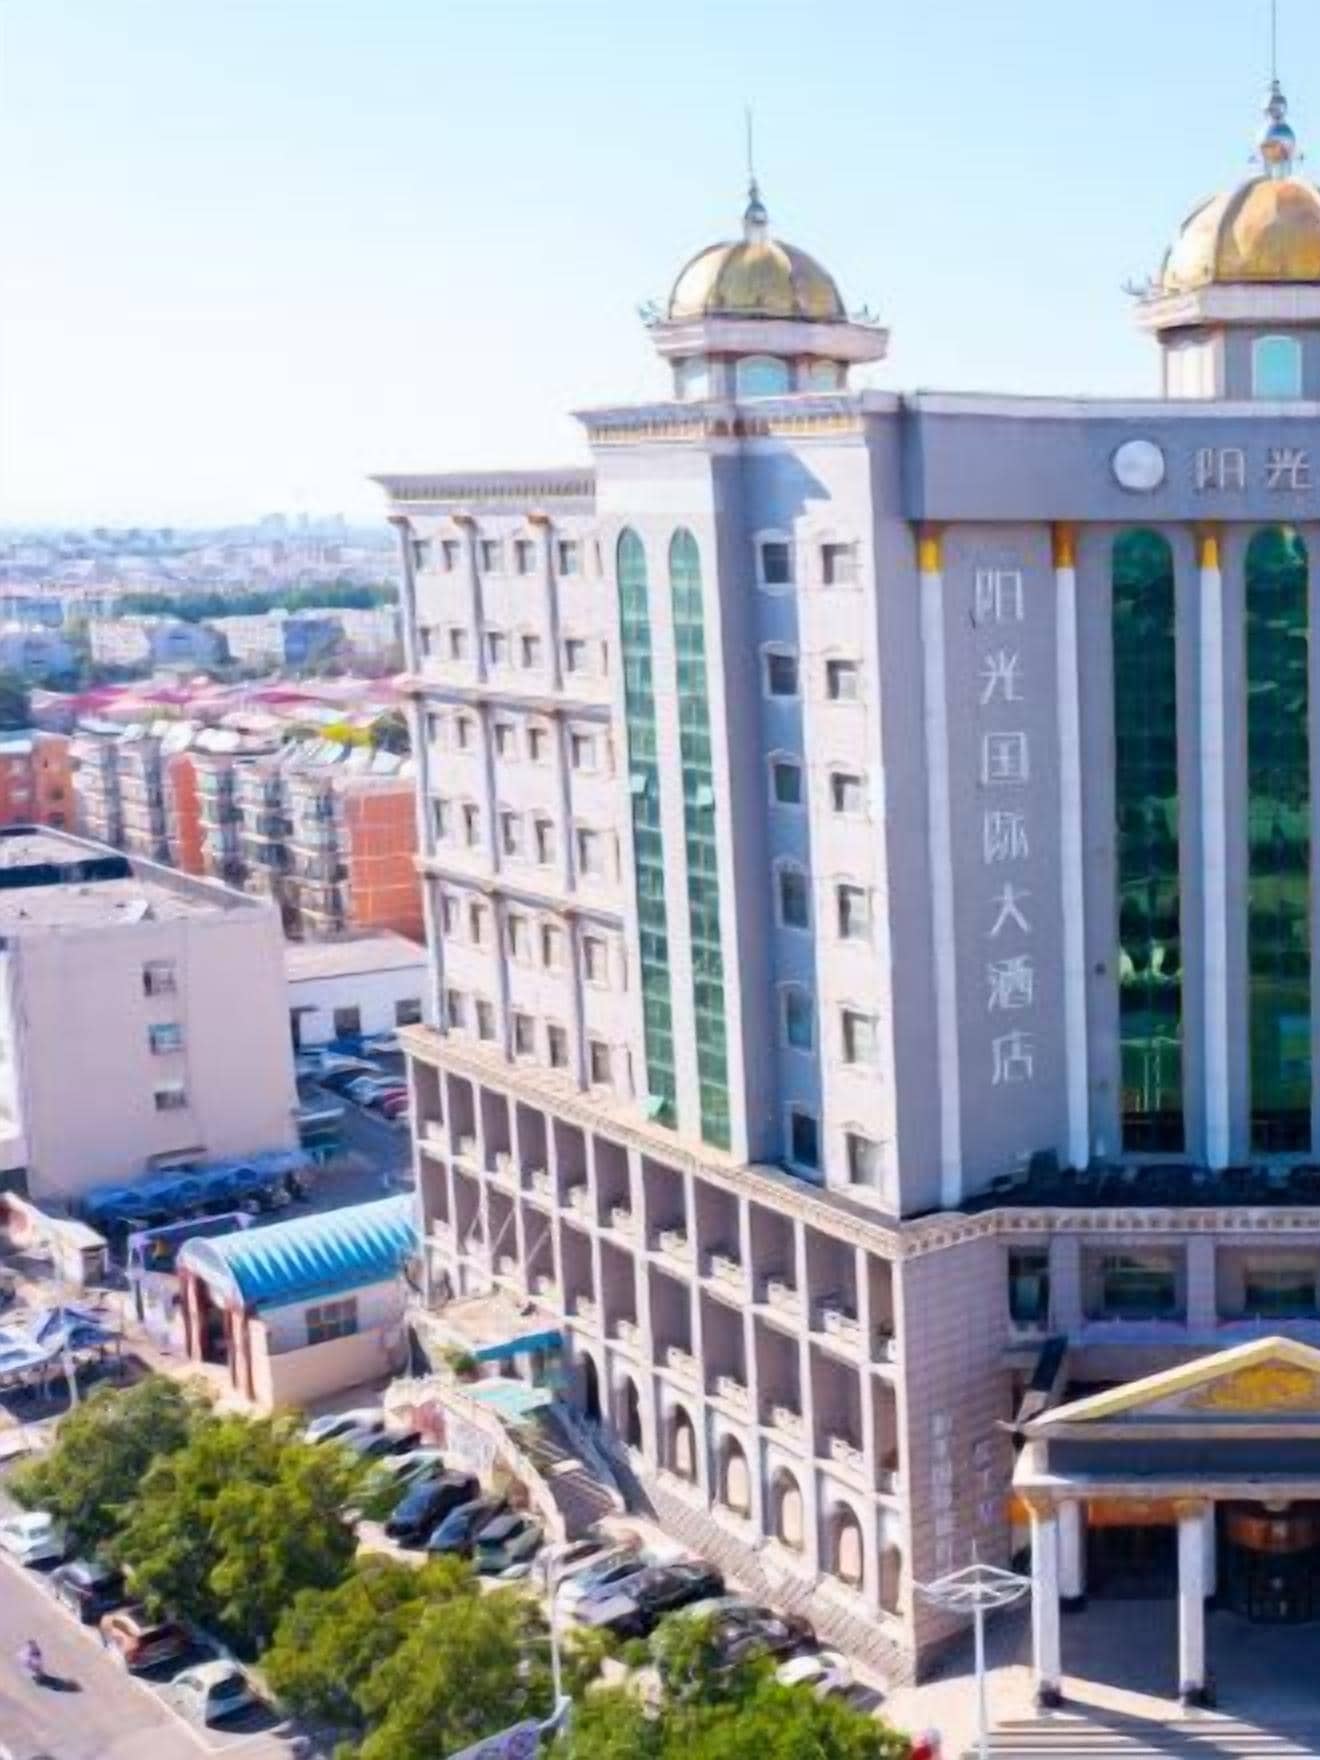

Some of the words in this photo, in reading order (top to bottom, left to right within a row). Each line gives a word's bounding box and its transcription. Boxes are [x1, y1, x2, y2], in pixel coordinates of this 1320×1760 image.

[974, 567, 1036, 1086] 阳光国际大酒店
